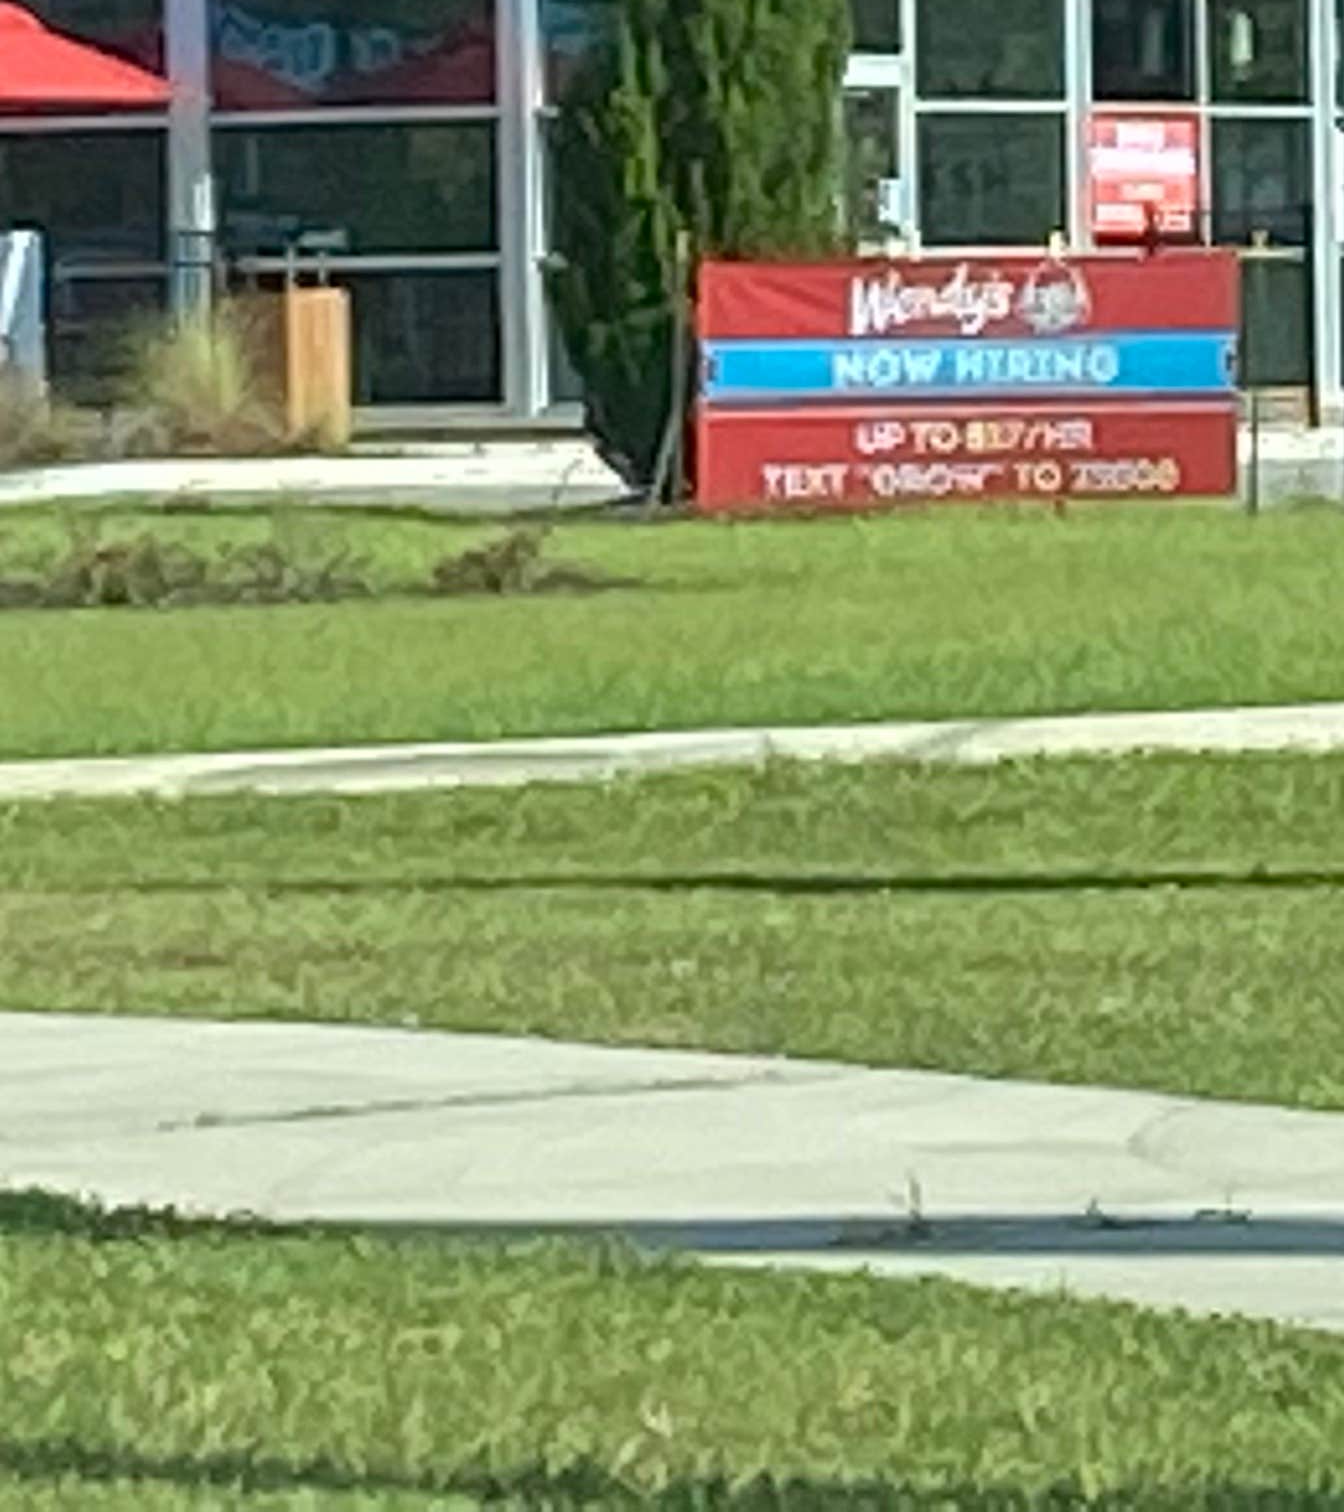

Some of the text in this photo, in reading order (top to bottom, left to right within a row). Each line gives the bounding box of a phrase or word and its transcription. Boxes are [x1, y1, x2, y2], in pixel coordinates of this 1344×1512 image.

[851, 263, 1014, 336] Wendy's
[833, 345, 1119, 386] NOW HIRING
[855, 423, 905, 454] UP
[912, 422, 959, 453] TO
[762, 464, 849, 498] TEXT
[1014, 462, 1061, 492] TO
